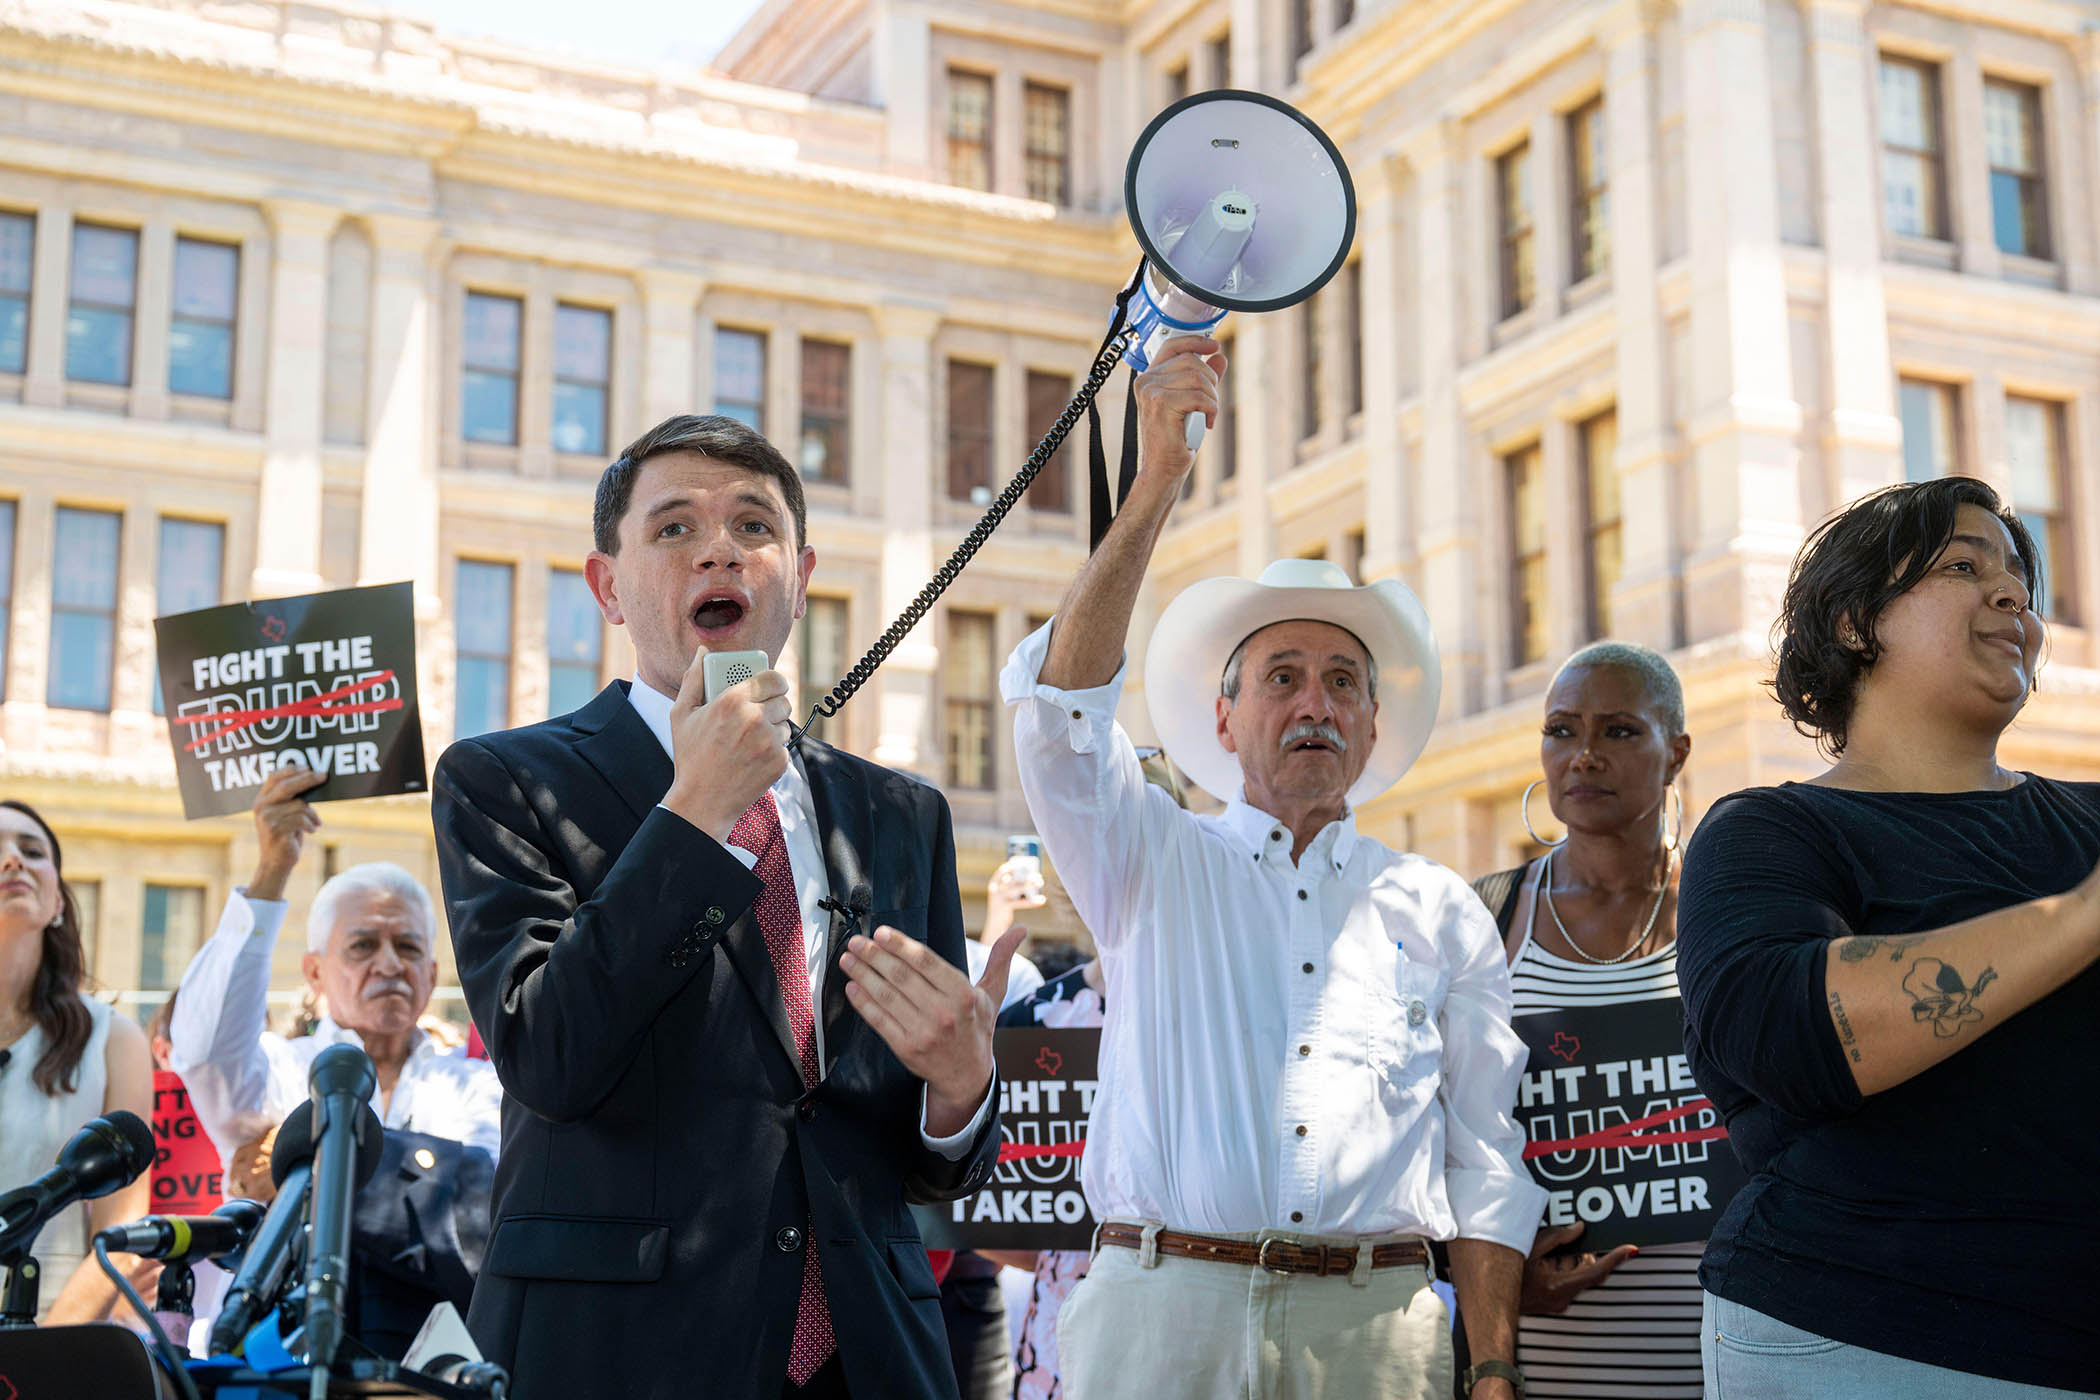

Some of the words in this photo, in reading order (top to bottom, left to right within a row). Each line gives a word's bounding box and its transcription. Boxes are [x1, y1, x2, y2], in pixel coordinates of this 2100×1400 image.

[193, 646, 290, 691] FIGHT
[296, 636, 373, 675] THE
[177, 670, 400, 759] TRUMP
[204, 741, 381, 792] TAKEOVER
[1596, 1054, 1698, 1098] THE
[1540, 1176, 1712, 1228] EOVER
